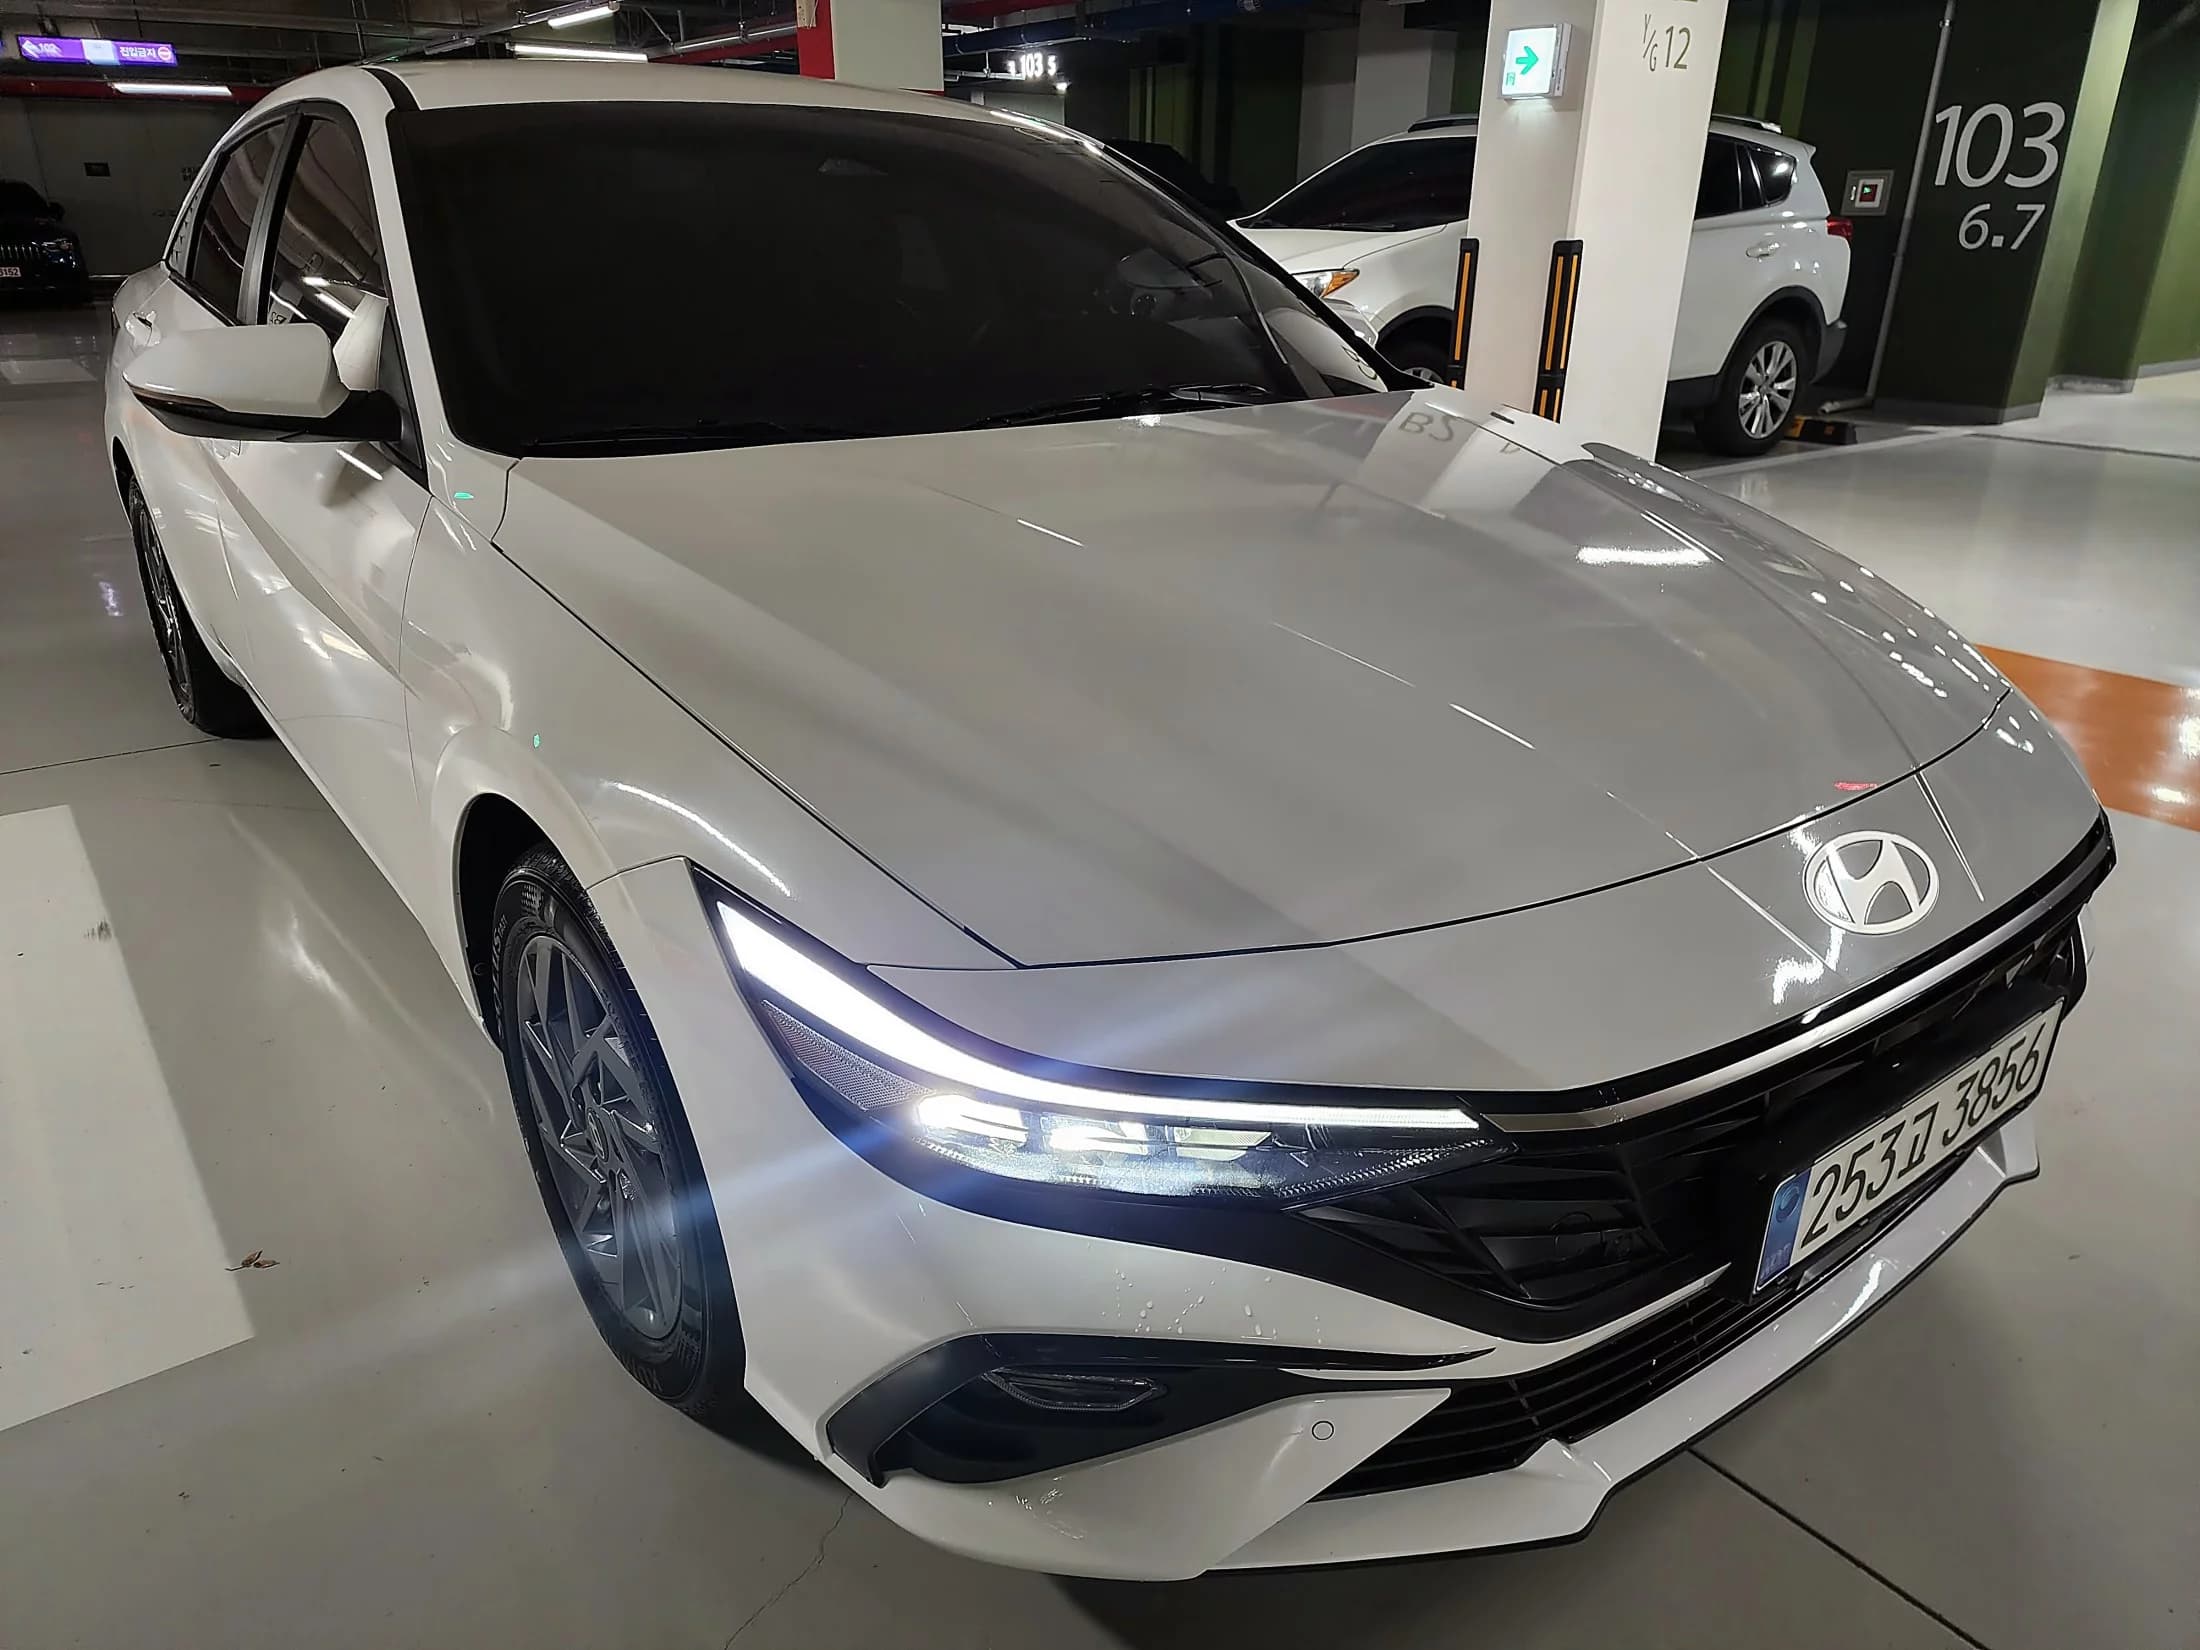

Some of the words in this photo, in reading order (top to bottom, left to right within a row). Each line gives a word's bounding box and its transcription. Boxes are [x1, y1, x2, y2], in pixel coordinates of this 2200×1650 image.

[119, 46, 157, 59] 진입금지
[1020, 52, 1043, 79] 103
[1664, 25, 1692, 70] 12
[1935, 101, 2066, 189] 103
[1958, 203, 2046, 250] 6.7
[1942, 1022, 2047, 1148] 3856
